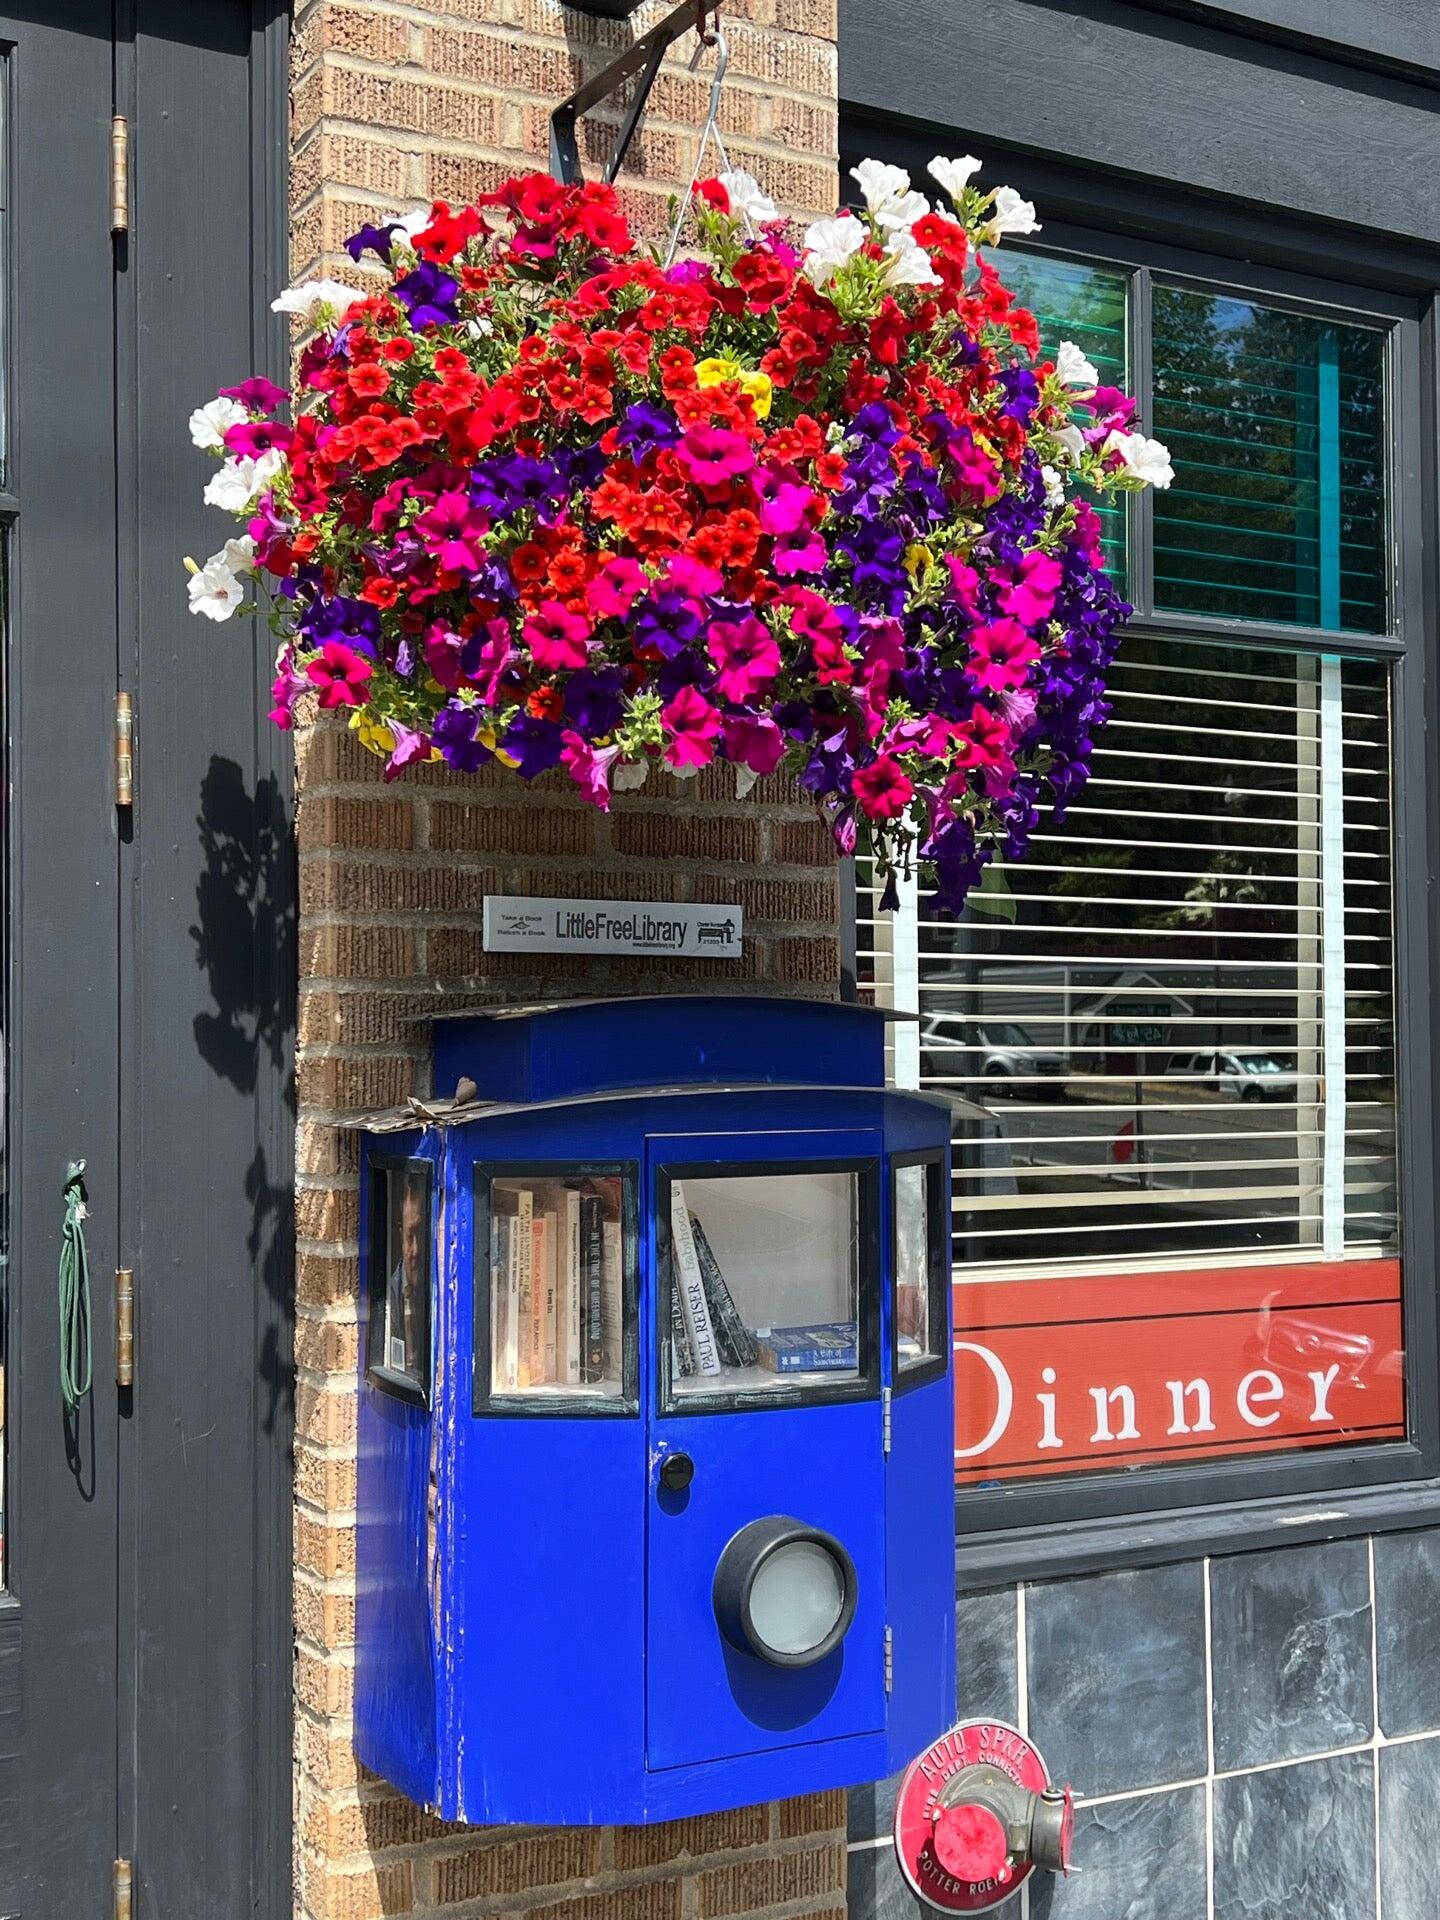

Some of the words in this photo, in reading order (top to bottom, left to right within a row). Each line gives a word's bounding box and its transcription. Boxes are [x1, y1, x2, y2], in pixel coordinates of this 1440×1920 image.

[556, 911, 688, 949] LittleFreeLibrary
[590, 1231, 600, 1241] IN
[590, 1242, 600, 1257] THE
[523, 1236, 531, 1271] UNDER
[590, 1258, 600, 1277] TIME
[590, 1279, 600, 1289] OF
[709, 1264, 728, 1298] VICTORIA
[671, 1286, 682, 1318] DEATH
[688, 1283, 708, 1334] REISER
[674, 1318, 683, 1330] IN
[697, 1334, 715, 1370] PAUL
[954, 1341, 1340, 1458] Dinner
[978, 1752, 1025, 1788] CONNECTI
[918, 1850, 961, 1895] POTTER
